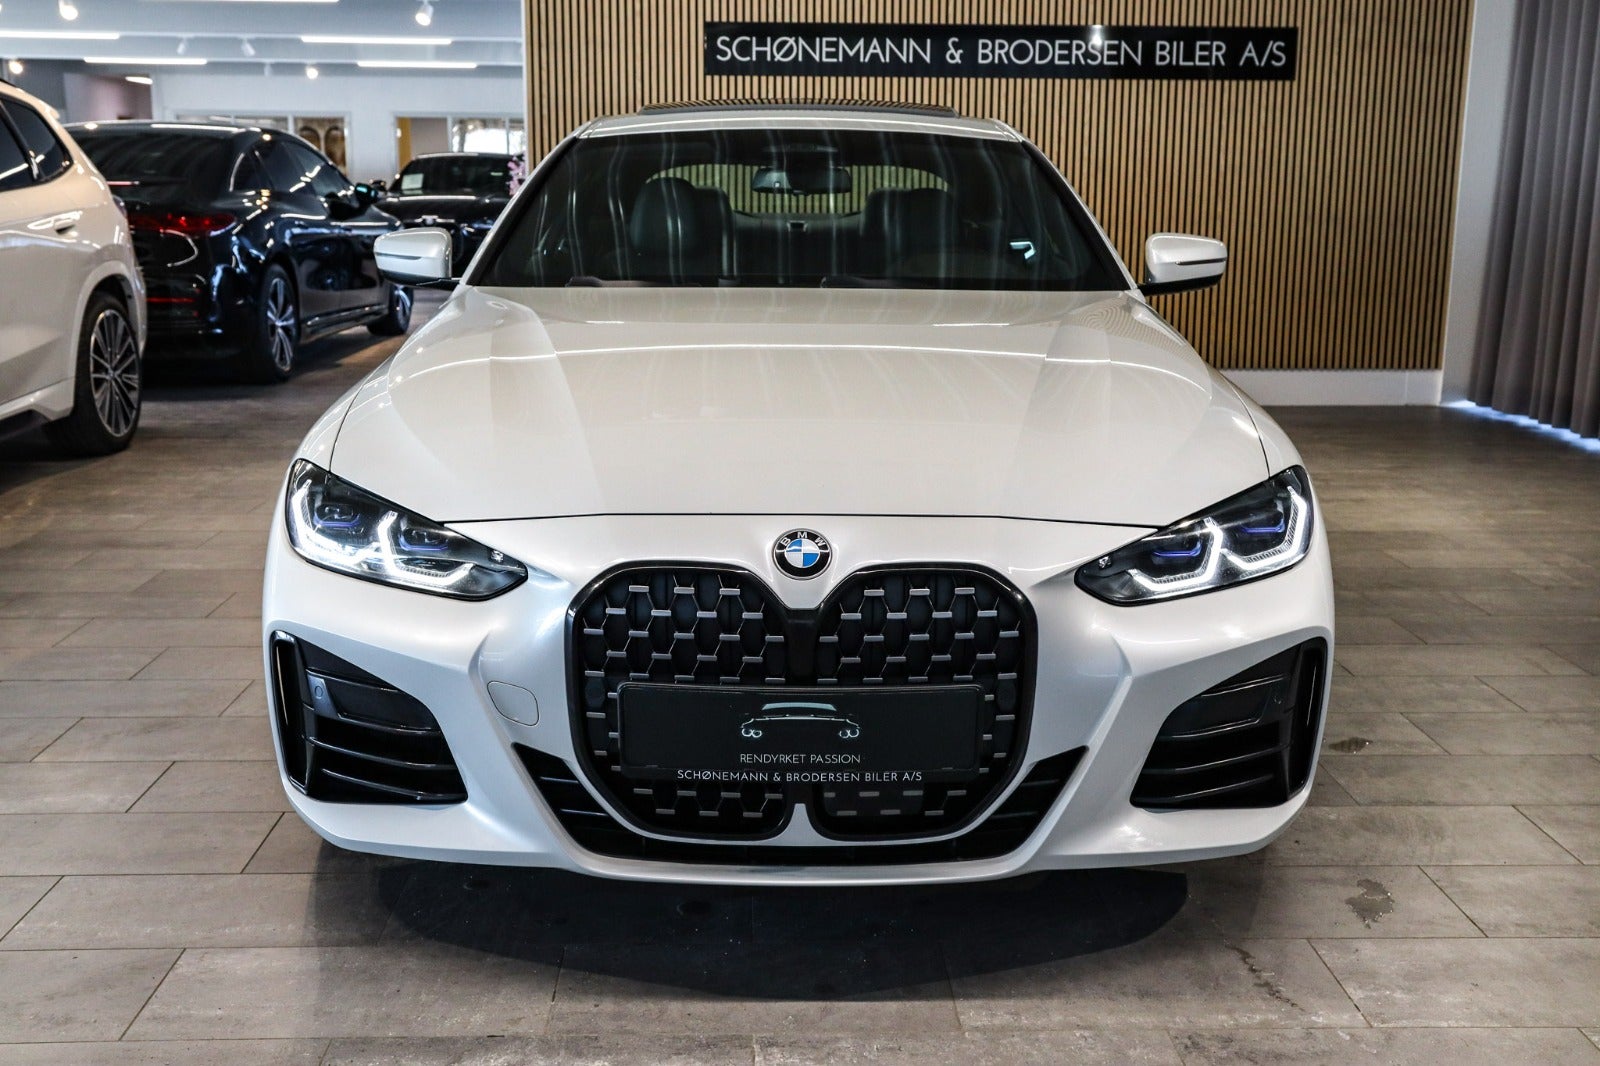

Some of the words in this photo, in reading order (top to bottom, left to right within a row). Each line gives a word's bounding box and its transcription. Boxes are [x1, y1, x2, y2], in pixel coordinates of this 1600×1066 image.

[716, 36, 931, 64] SCHØNEMANN
[945, 37, 964, 64] &
[977, 39, 1142, 66] BRODERSEN
[1155, 40, 1226, 66] BILER
[1239, 40, 1286, 67] A/S
[780, 531, 826, 547] BMW
[740, 753, 806, 764] RENDYRKET
[810, 754, 861, 764] PASSION
[677, 769, 768, 782] SCHØNEMANN
[773, 772, 781, 782] &
[786, 772, 860, 782] BRODERSEN
[865, 772, 898, 782] BILER
[902, 771, 922, 781] A/S
